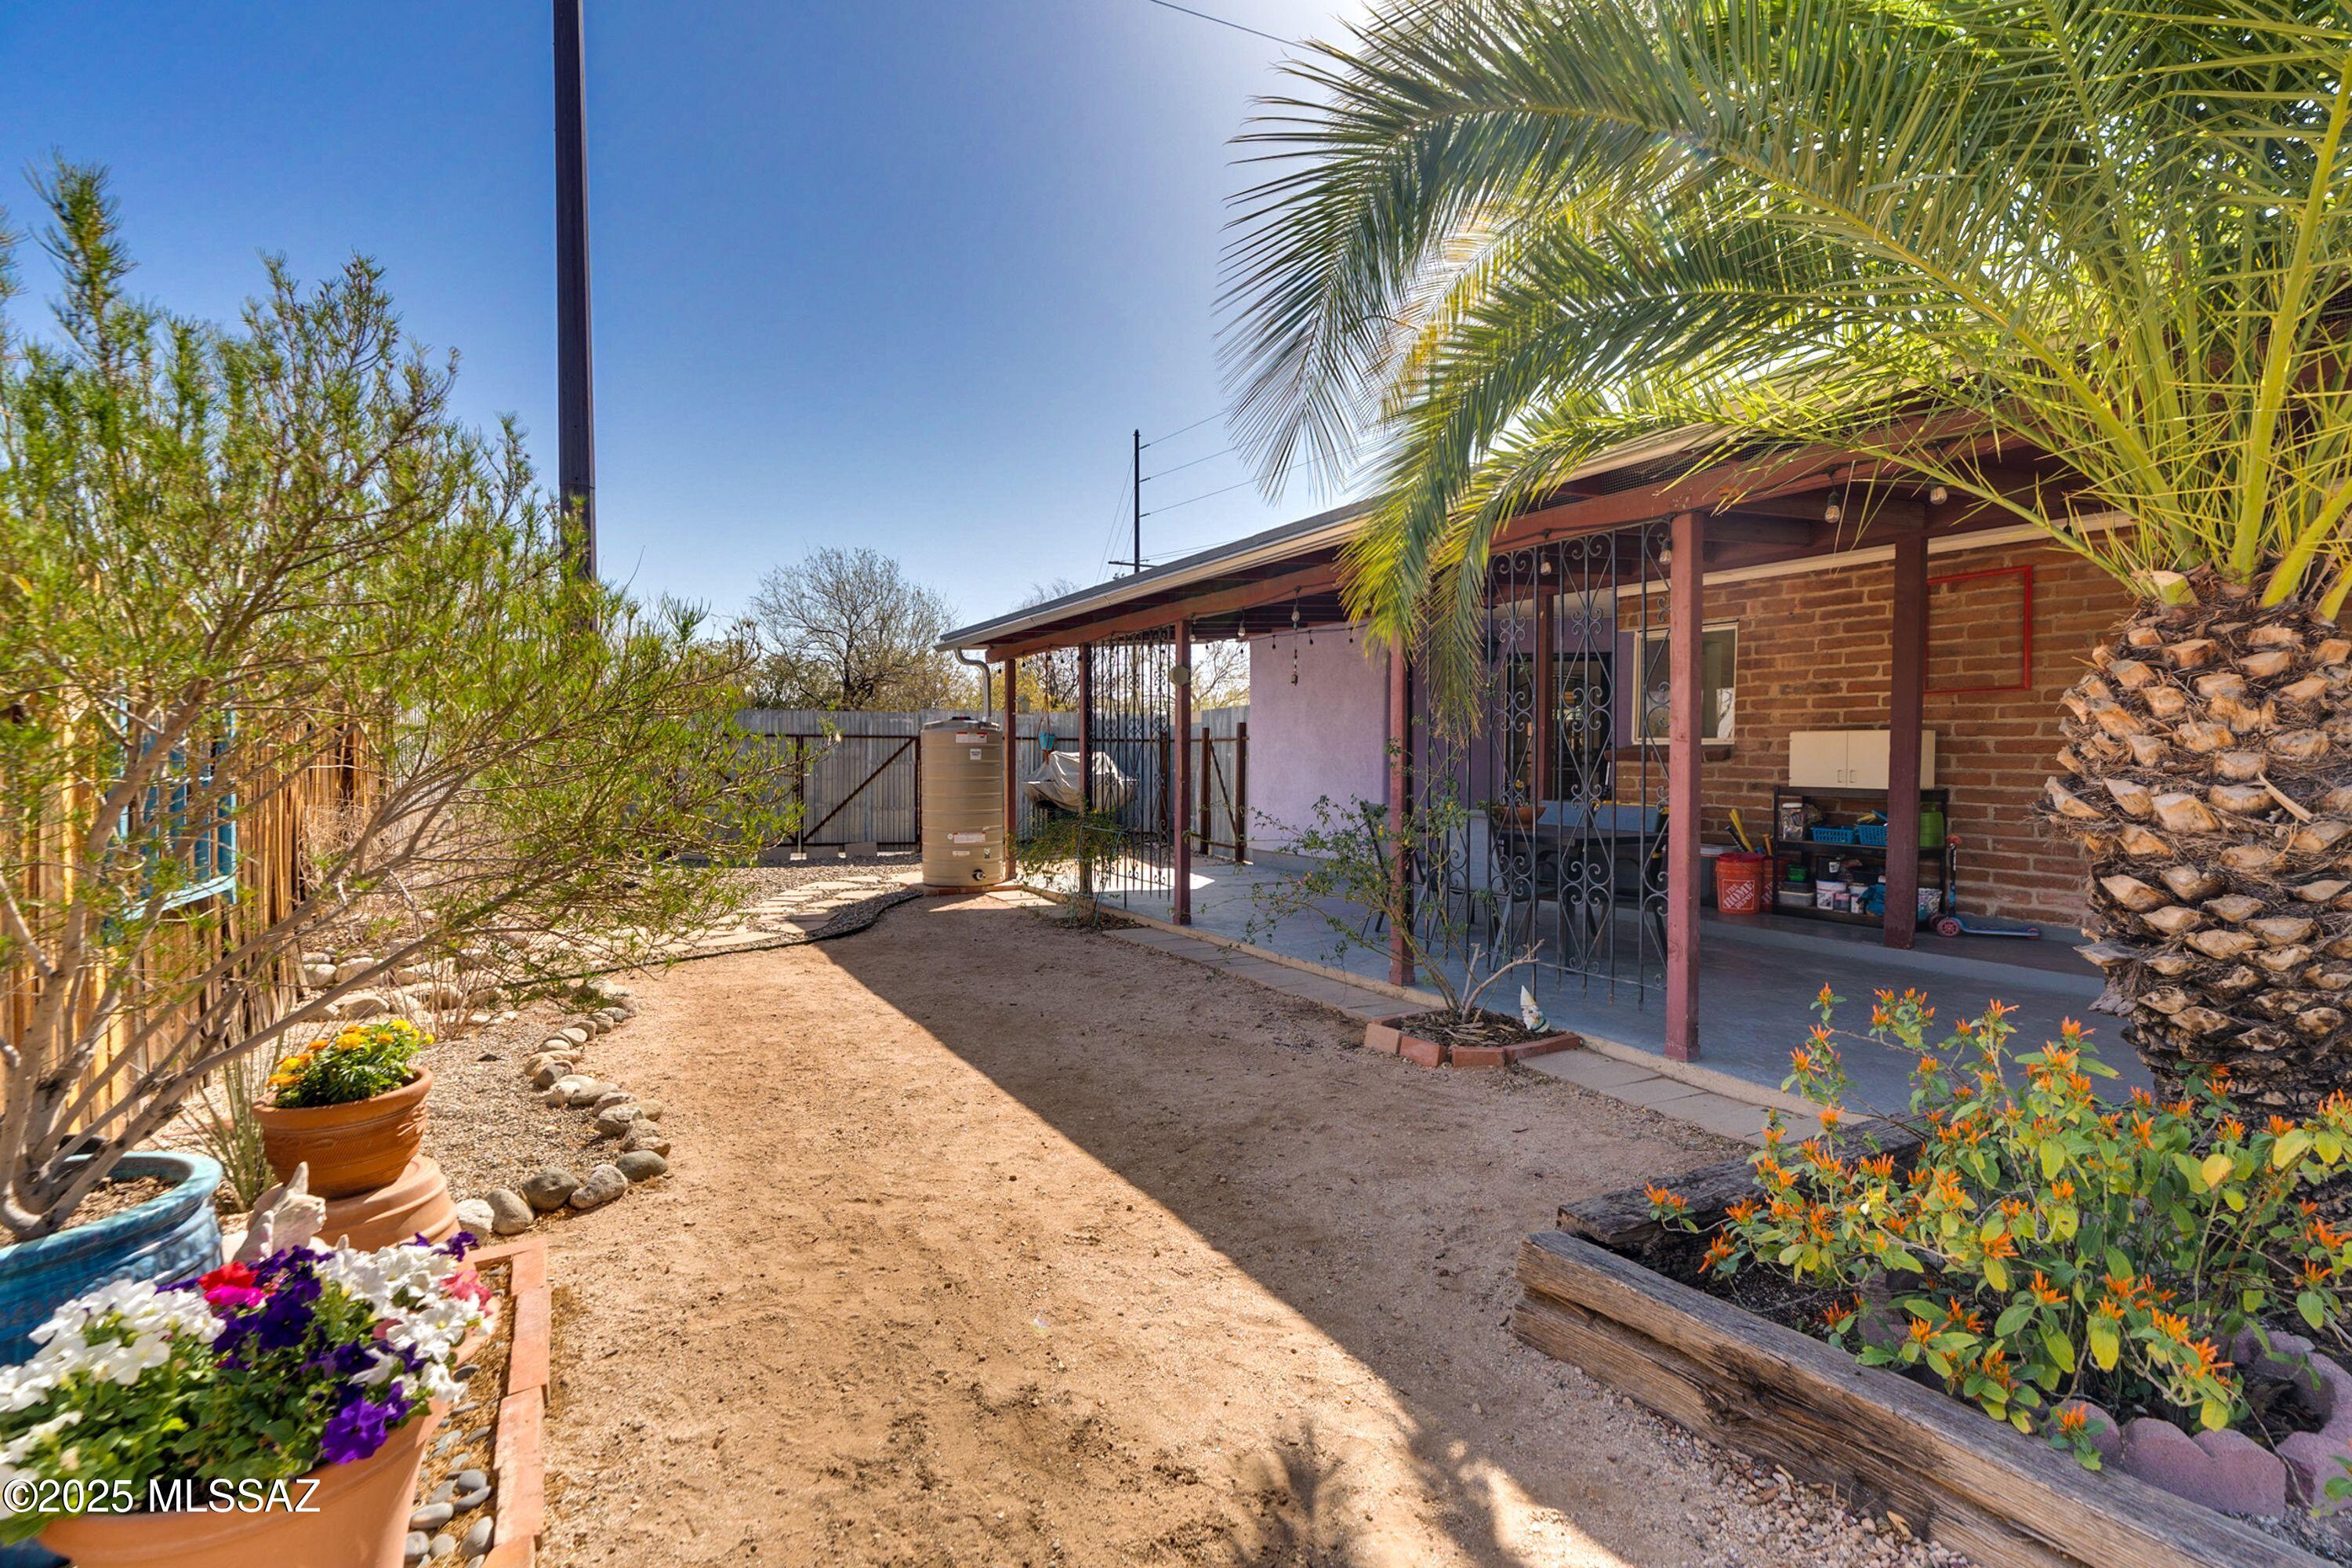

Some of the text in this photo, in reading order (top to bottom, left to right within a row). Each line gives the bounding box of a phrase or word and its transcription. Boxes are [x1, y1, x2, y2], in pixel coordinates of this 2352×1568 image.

[1723, 880, 1755, 909] HOME
[1726, 883, 1740, 895] THE
[1734, 891, 1755, 909] DEPOT
